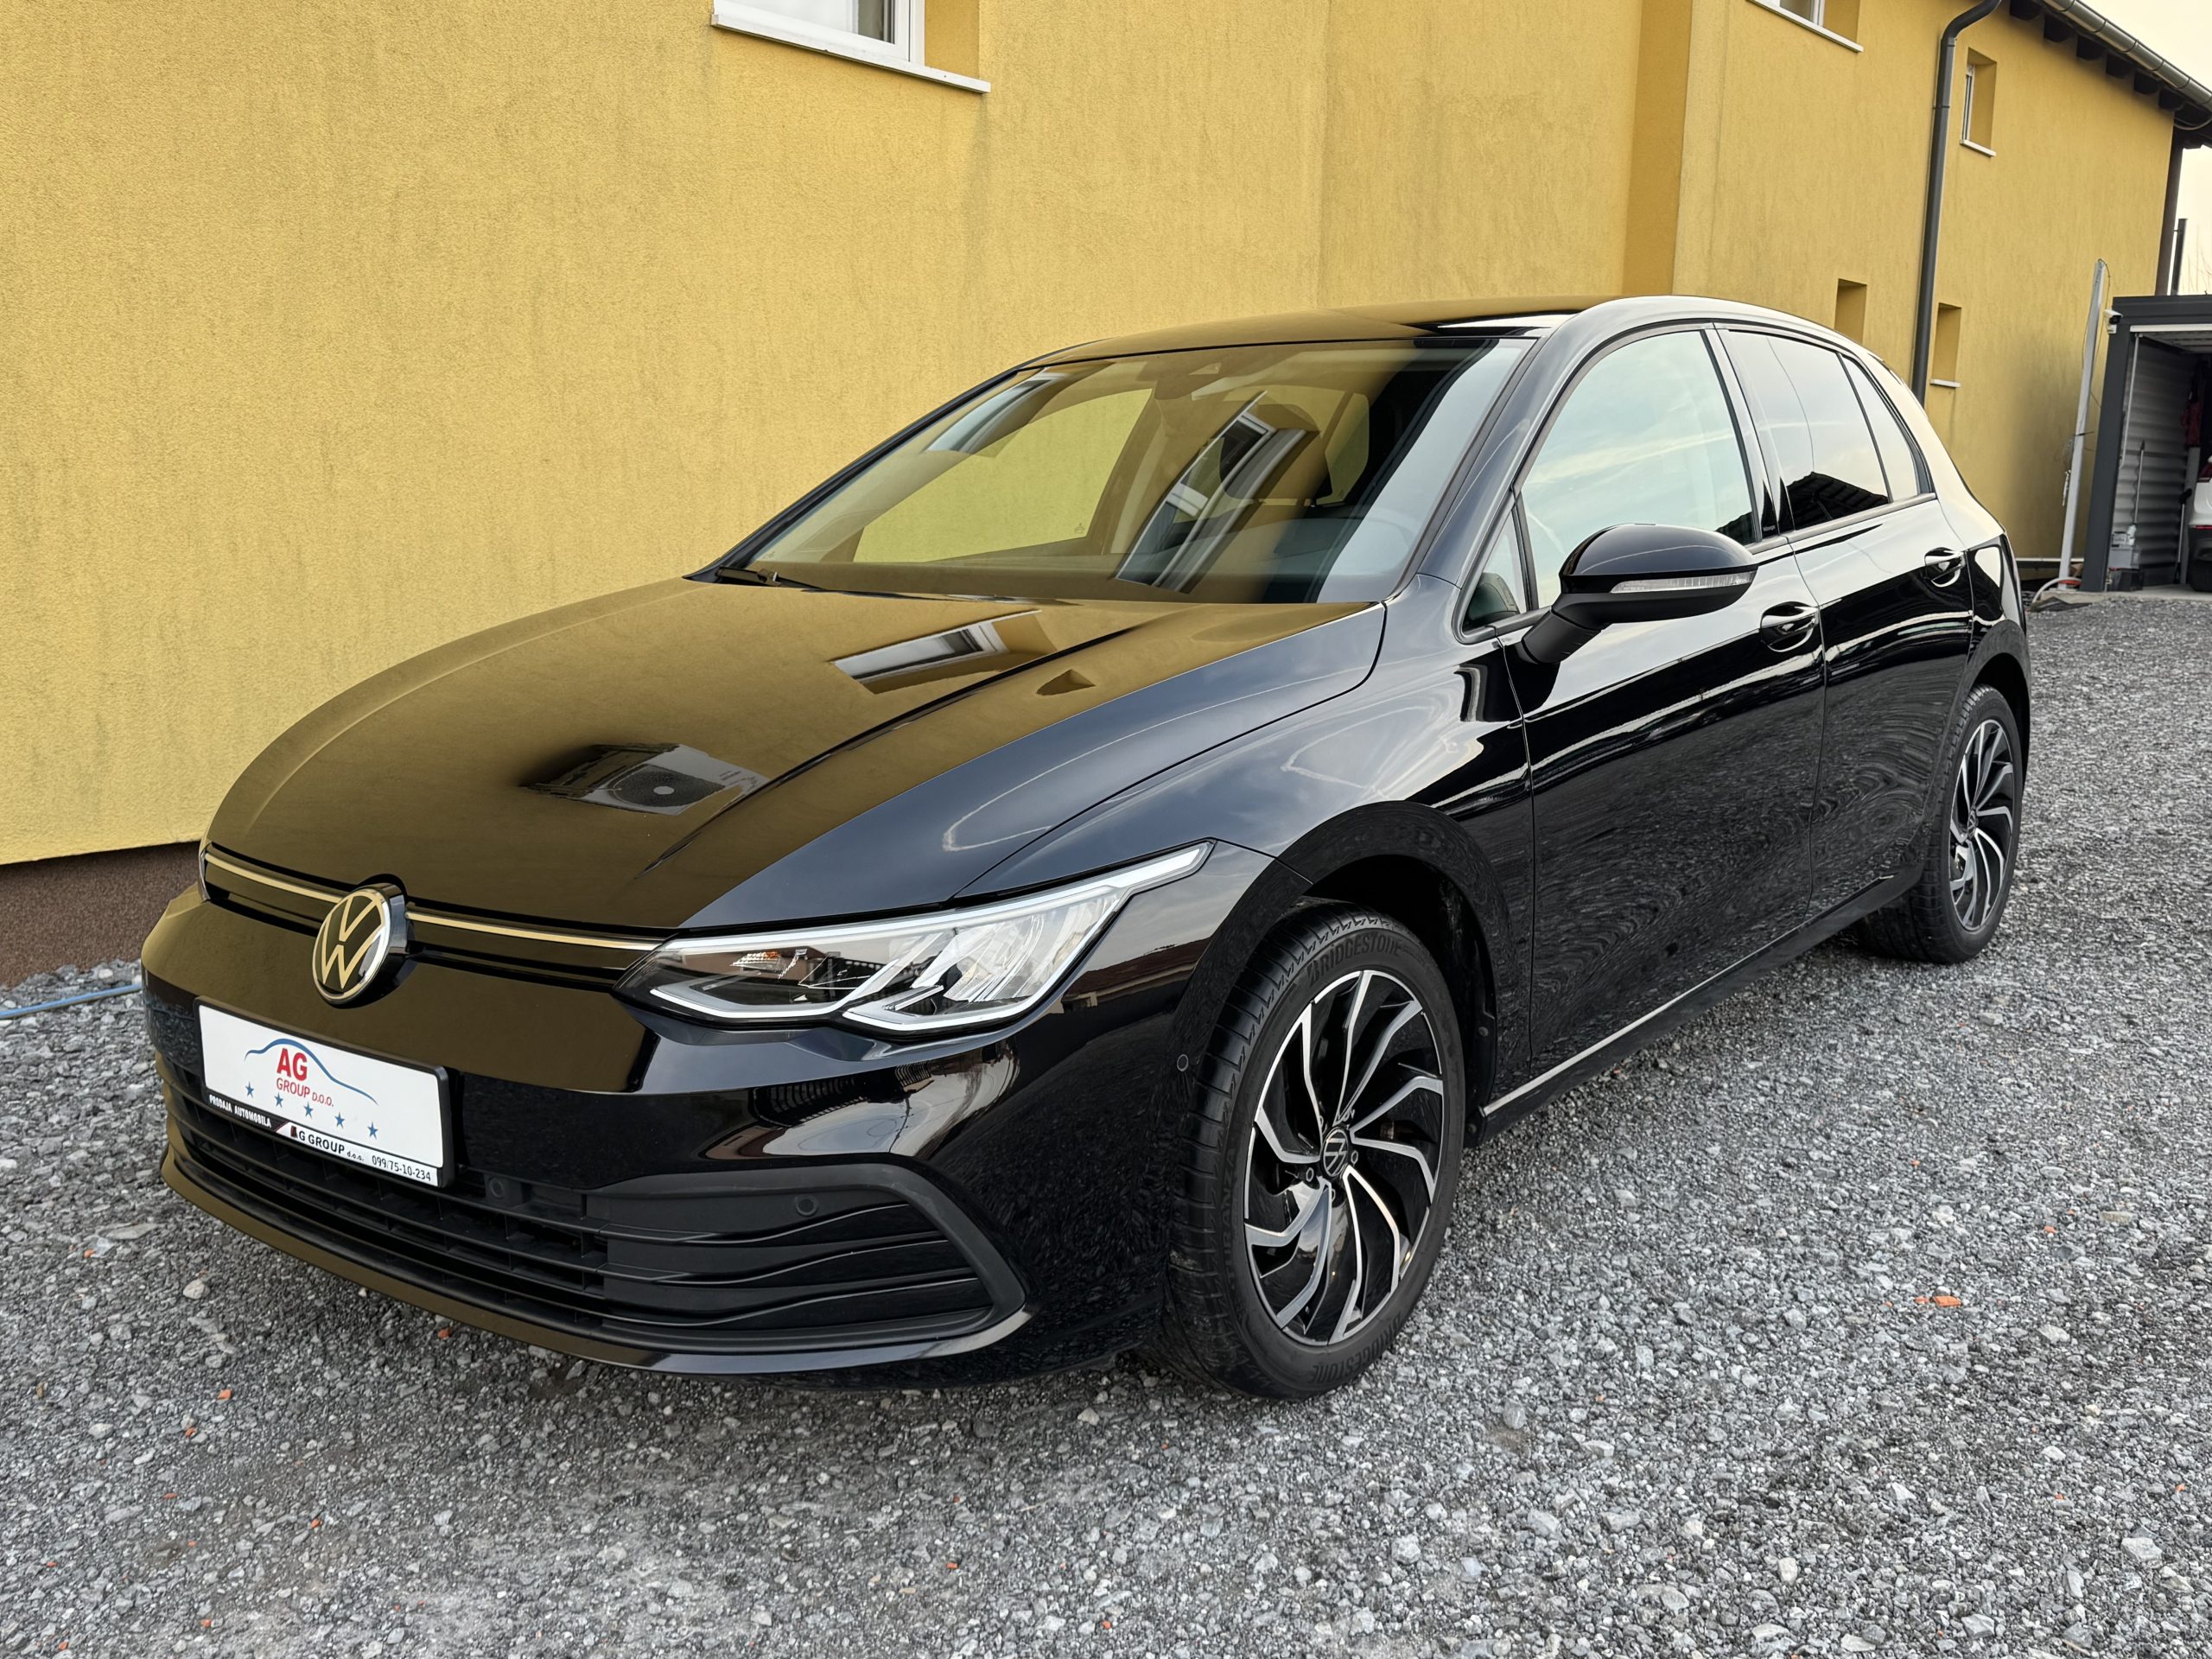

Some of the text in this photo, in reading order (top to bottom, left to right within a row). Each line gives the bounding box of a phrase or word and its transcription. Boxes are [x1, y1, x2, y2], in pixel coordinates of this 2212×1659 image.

[276, 1047, 307, 1081] AG
[276, 1077, 334, 1107] GROUP D.O.O.
[209, 1094, 272, 1128] PRODAJA AUTOMOBILA
[308, 1134, 345, 1154] GROUP
